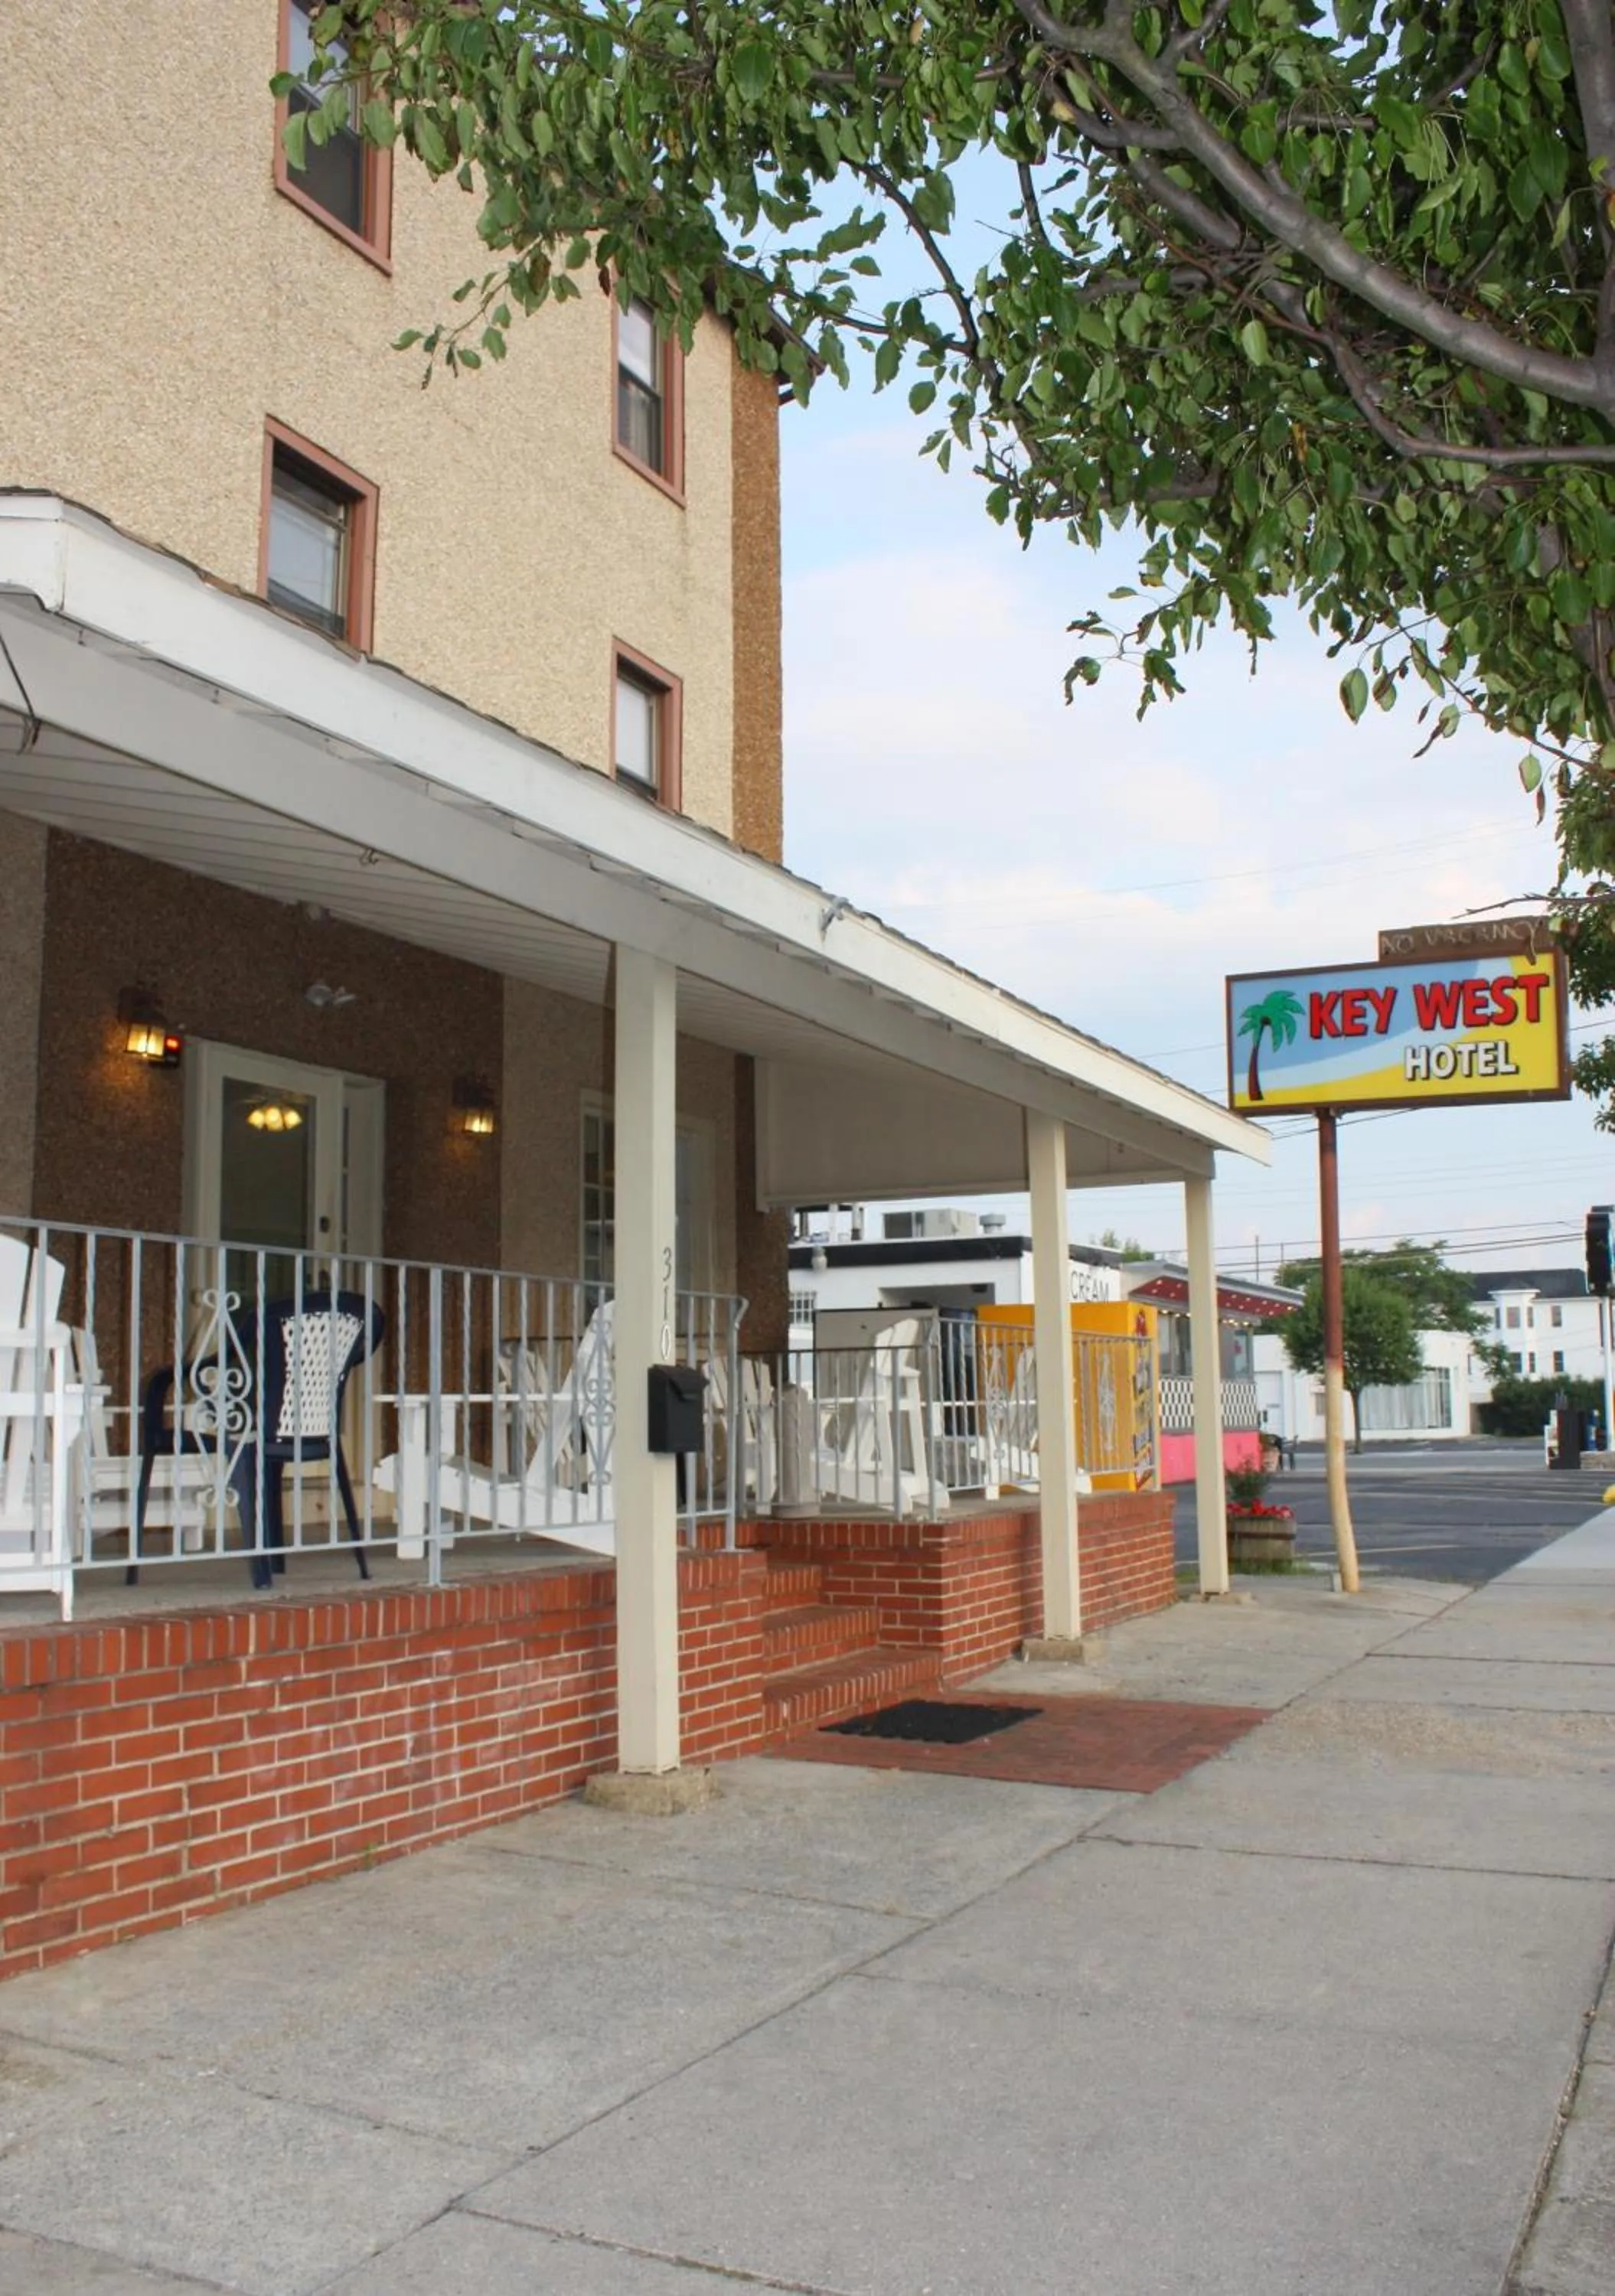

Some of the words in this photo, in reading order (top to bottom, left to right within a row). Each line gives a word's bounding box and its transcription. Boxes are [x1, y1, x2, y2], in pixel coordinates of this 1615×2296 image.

[1380, 933, 1414, 956] NO
[1310, 987, 1397, 1039] KEY
[1413, 974, 1550, 1031] WEST
[1404, 1040, 1519, 1081] HOTEL
[661, 1247, 672, 1360] 310
